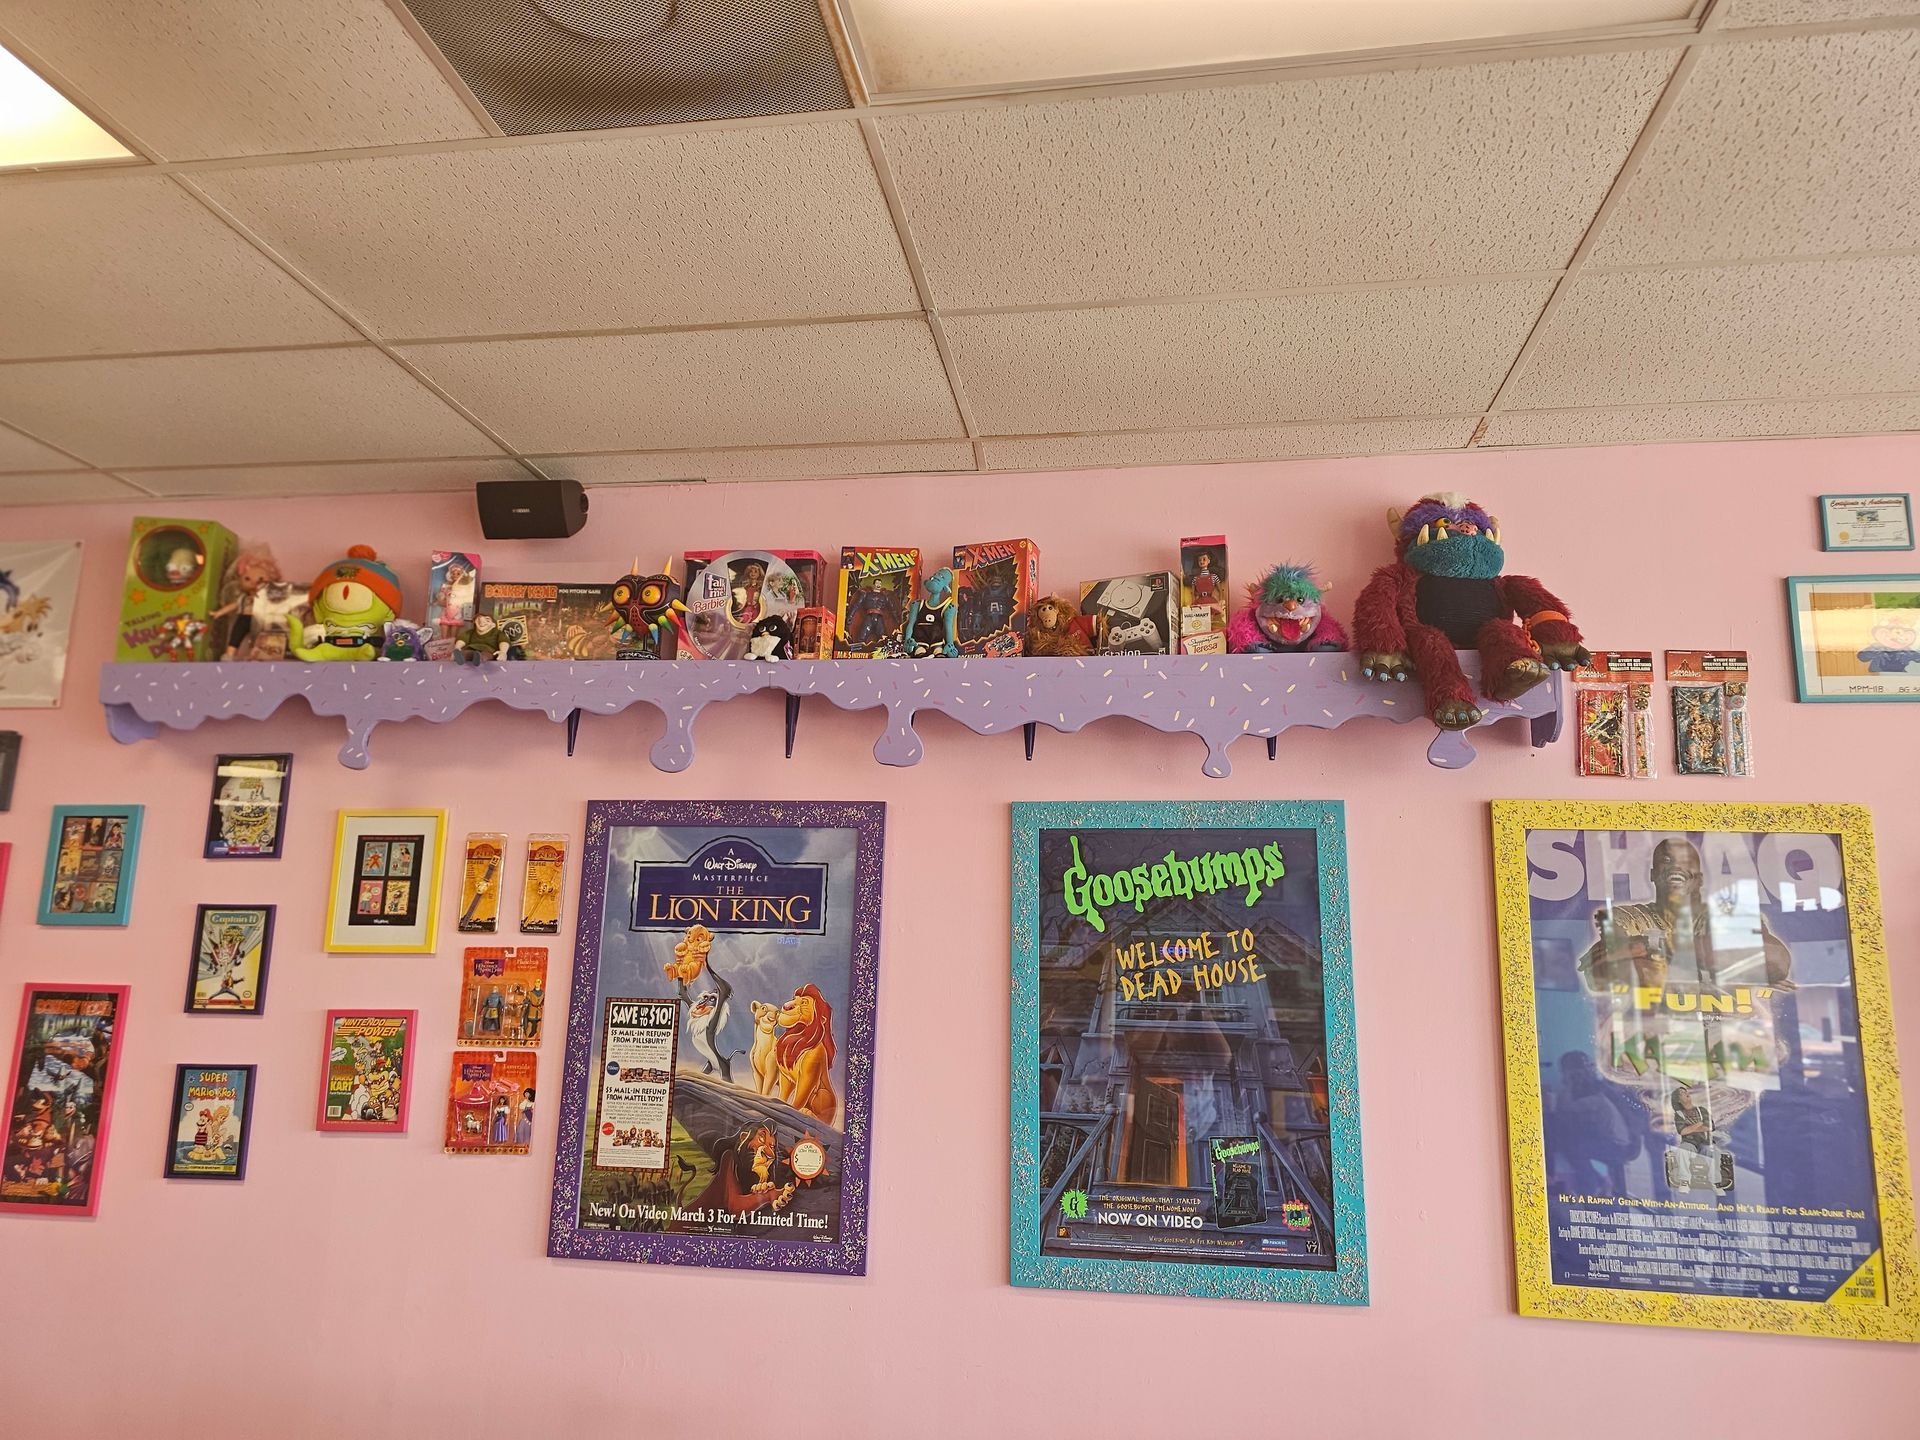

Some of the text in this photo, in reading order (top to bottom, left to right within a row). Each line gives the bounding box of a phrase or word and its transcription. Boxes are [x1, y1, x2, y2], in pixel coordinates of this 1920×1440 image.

[857, 552, 915, 574] X-MEN
[967, 544, 1016, 567] X-MEN
[485, 584, 527, 598] DONKEY
[528, 585, 558, 599] KONG
[693, 598, 725, 614] Barbie
[1192, 642, 1218, 654] Teresa
[704, 857, 757, 873] Walt Disney
[1526, 830, 1843, 906] SHAQ
[692, 873, 769, 882] MASTERPIECE
[1064, 836, 1285, 932] Goosebumps
[716, 886, 744, 895] THE
[648, 894, 812, 923] LION KING
[1116, 928, 1254, 971] WELCOME TO
[1119, 954, 1267, 1002] DEAD HOUSE
[341, 1019, 386, 1027] NINTENDO
[612, 1004, 673, 1026] SAVE UP TO $10!
[357, 1027, 399, 1036] POWER
[646, 1030, 671, 1038] REFUND
[199, 1072, 228, 1084] SUPER
[330, 1080, 353, 1092] KART
[188, 1086, 216, 1099] MARIO
[1215, 1140, 1260, 1163] Goosebumps
[1176, 1197, 1201, 1205] STARTED
[1579, 1195, 1585, 1204] A
[1756, 1205, 1779, 1215] READY
[1782, 1206, 1797, 1216] FOR
[1800, 1207, 1844, 1218] SLAM-DUNK
[1846, 1209, 1866, 1220] FUN!
[589, 1203, 829, 1229] New! On Video March 3 For A Limited Time!
[1098, 1212, 1203, 1229] NOW ON VIDEO
[1855, 1276, 1875, 1287] LAUGHS
[1845, 1288, 1876, 1298] START SOON!
